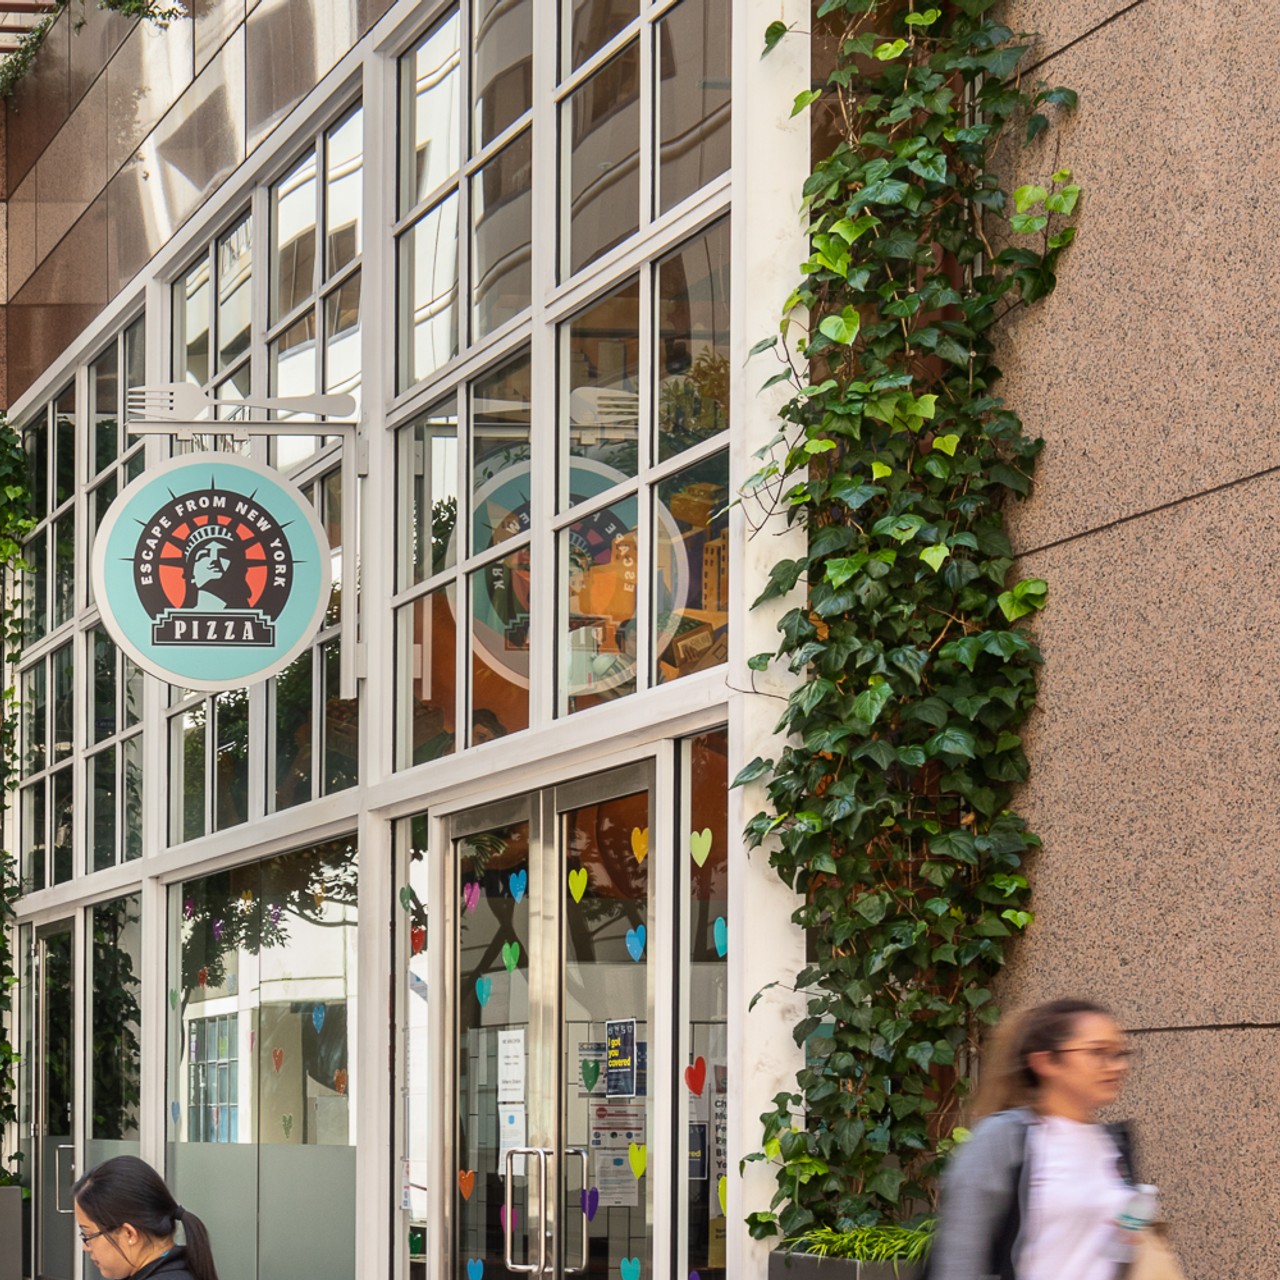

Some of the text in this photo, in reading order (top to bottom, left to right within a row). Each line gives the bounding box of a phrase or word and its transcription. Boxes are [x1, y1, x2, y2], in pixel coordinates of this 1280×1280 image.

[140, 496, 287, 588] ESCAPE FROM NEW YORK
[174, 620, 255, 641] PIZZA
